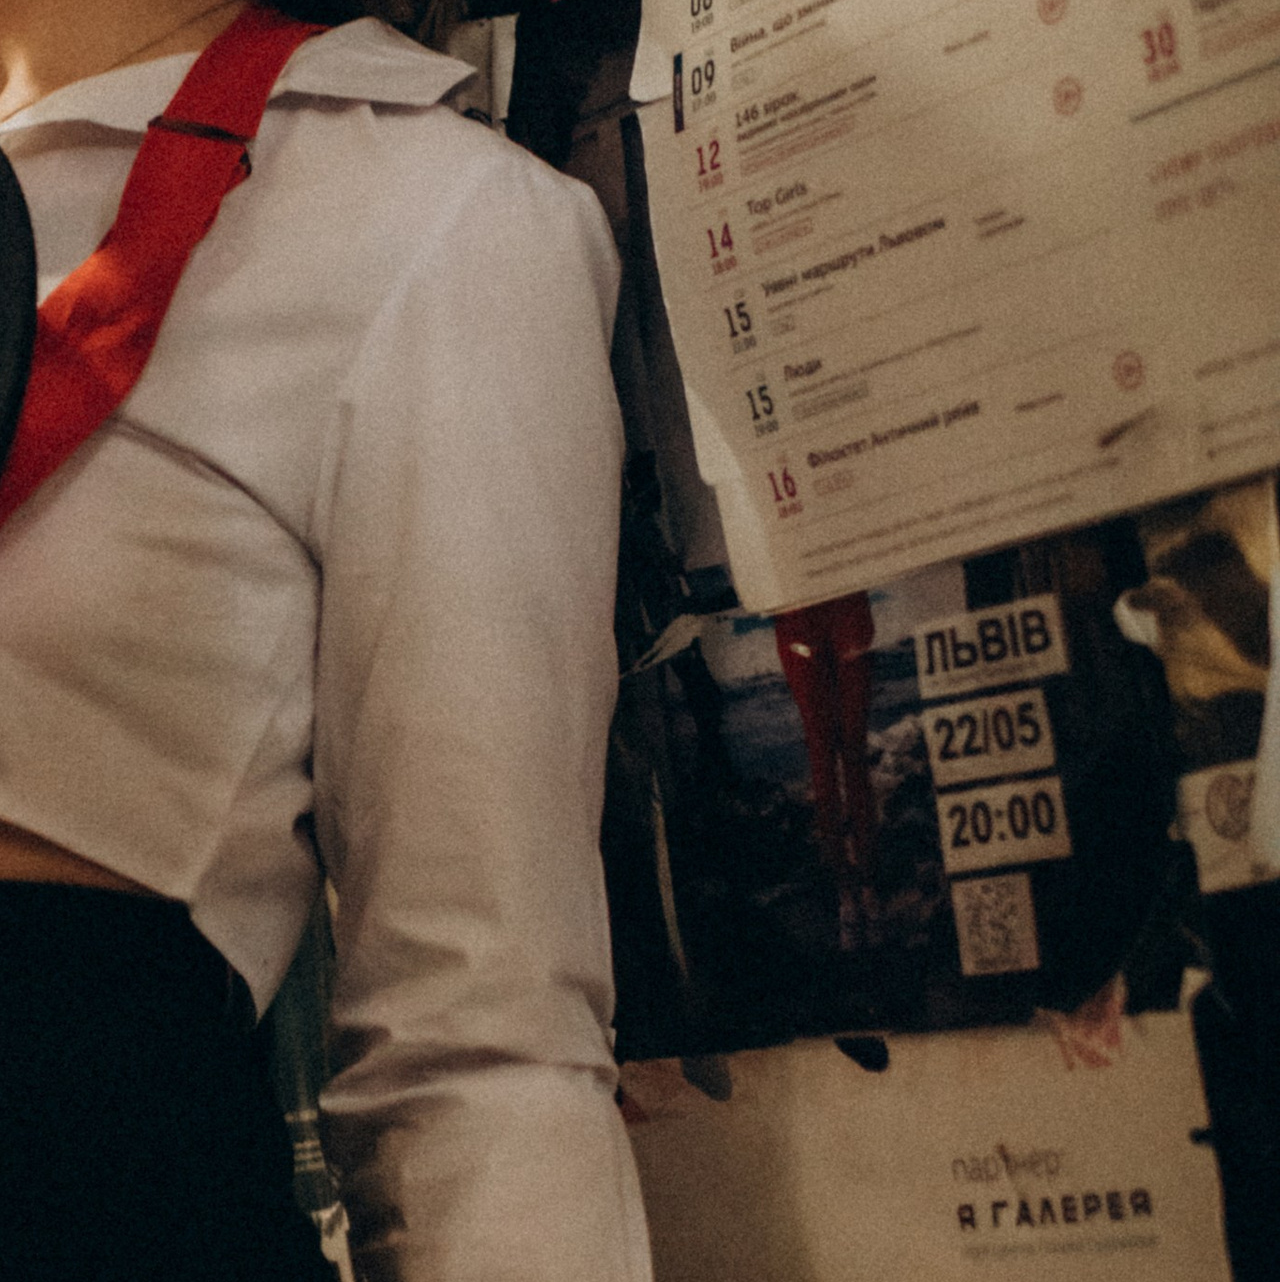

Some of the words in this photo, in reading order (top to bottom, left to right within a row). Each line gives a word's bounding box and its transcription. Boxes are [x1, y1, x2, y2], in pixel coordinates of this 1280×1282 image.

[691, 59, 716, 96] 09
[734, 104, 760, 129] 146
[696, 140, 721, 178] 12
[746, 197, 774, 217] Top
[774, 181, 809, 206] Girls
[707, 222, 734, 260] 14
[724, 301, 753, 339] 15
[746, 384, 775, 422] 15
[768, 467, 799, 504] 16
[924, 609, 1051, 674] ЛЬВІВ
[934, 701, 1041, 760] 22/05
[948, 791, 1056, 848] 20:00
[991, 1187, 1153, 1228] ГАЛЕРЕЯ
